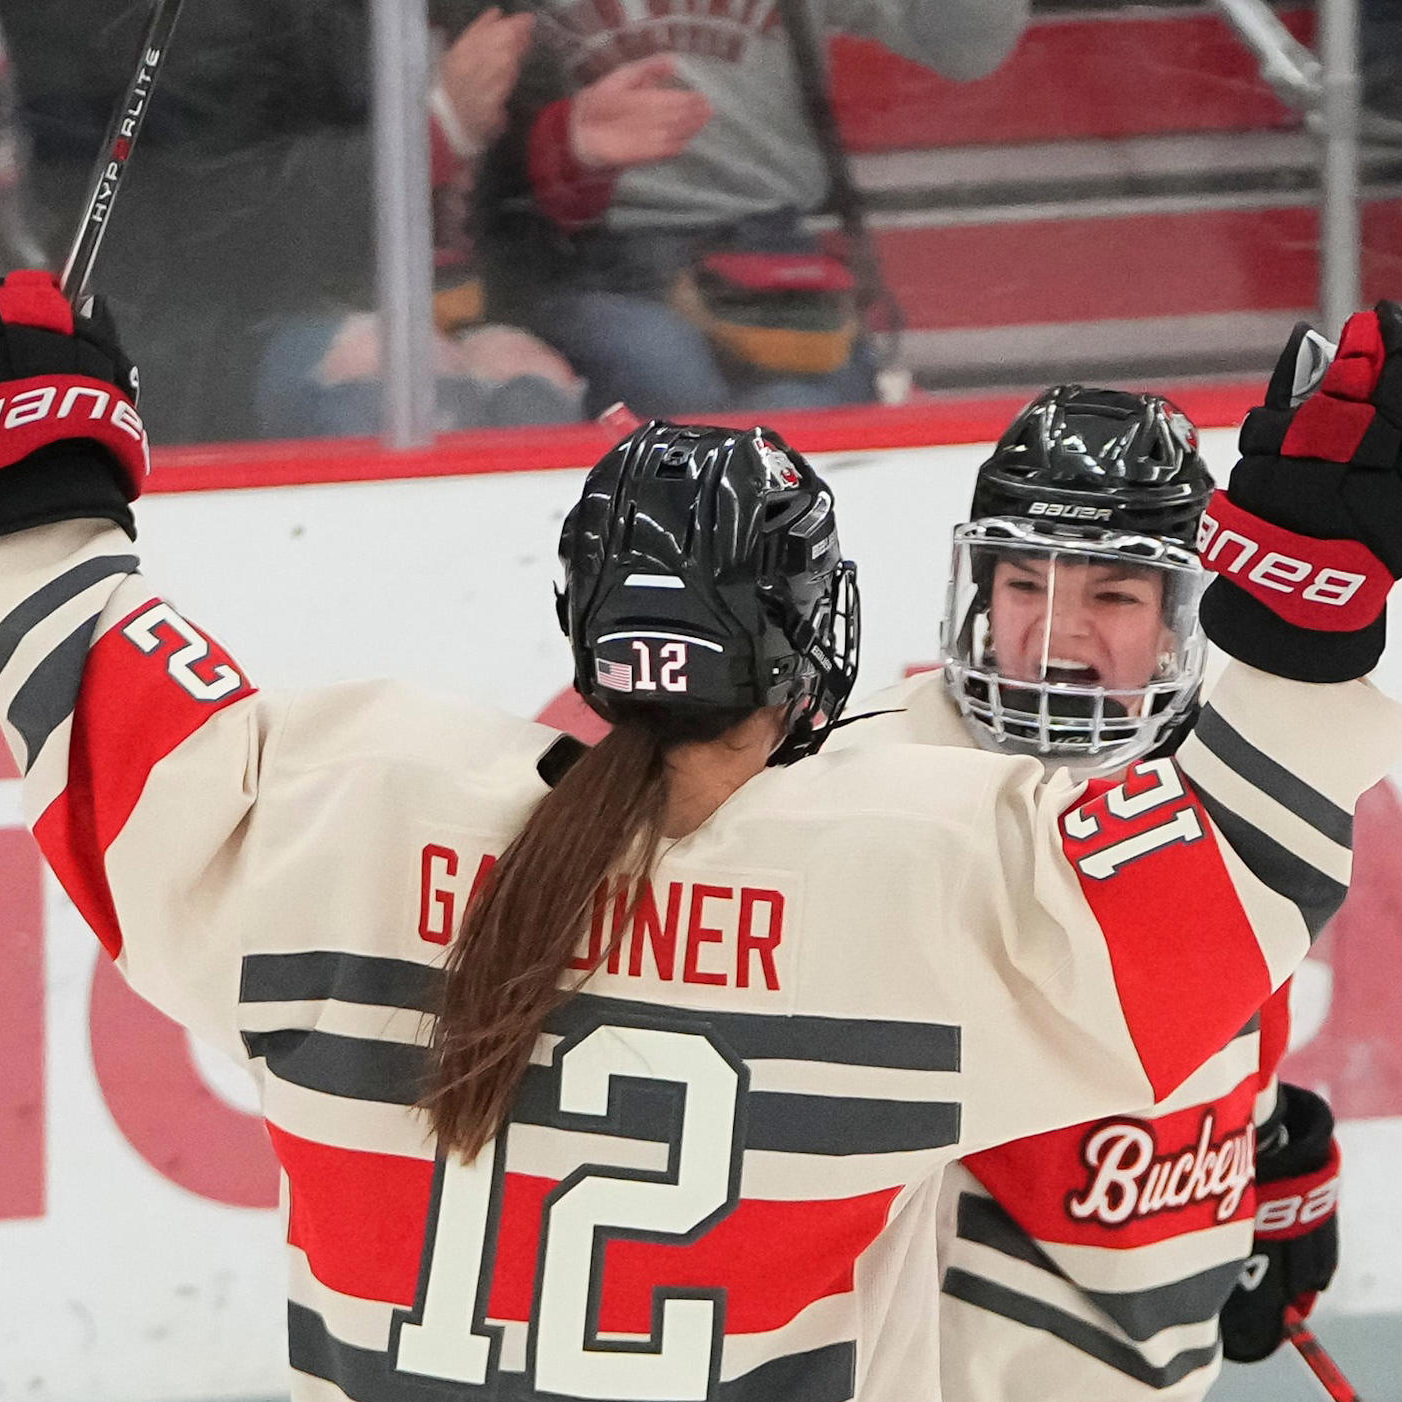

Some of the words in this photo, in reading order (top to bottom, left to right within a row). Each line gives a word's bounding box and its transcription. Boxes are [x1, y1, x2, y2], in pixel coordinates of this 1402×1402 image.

[631, 640, 688, 692] 12
[1062, 755, 1205, 881] 12
[418, 842, 786, 991] GINER
